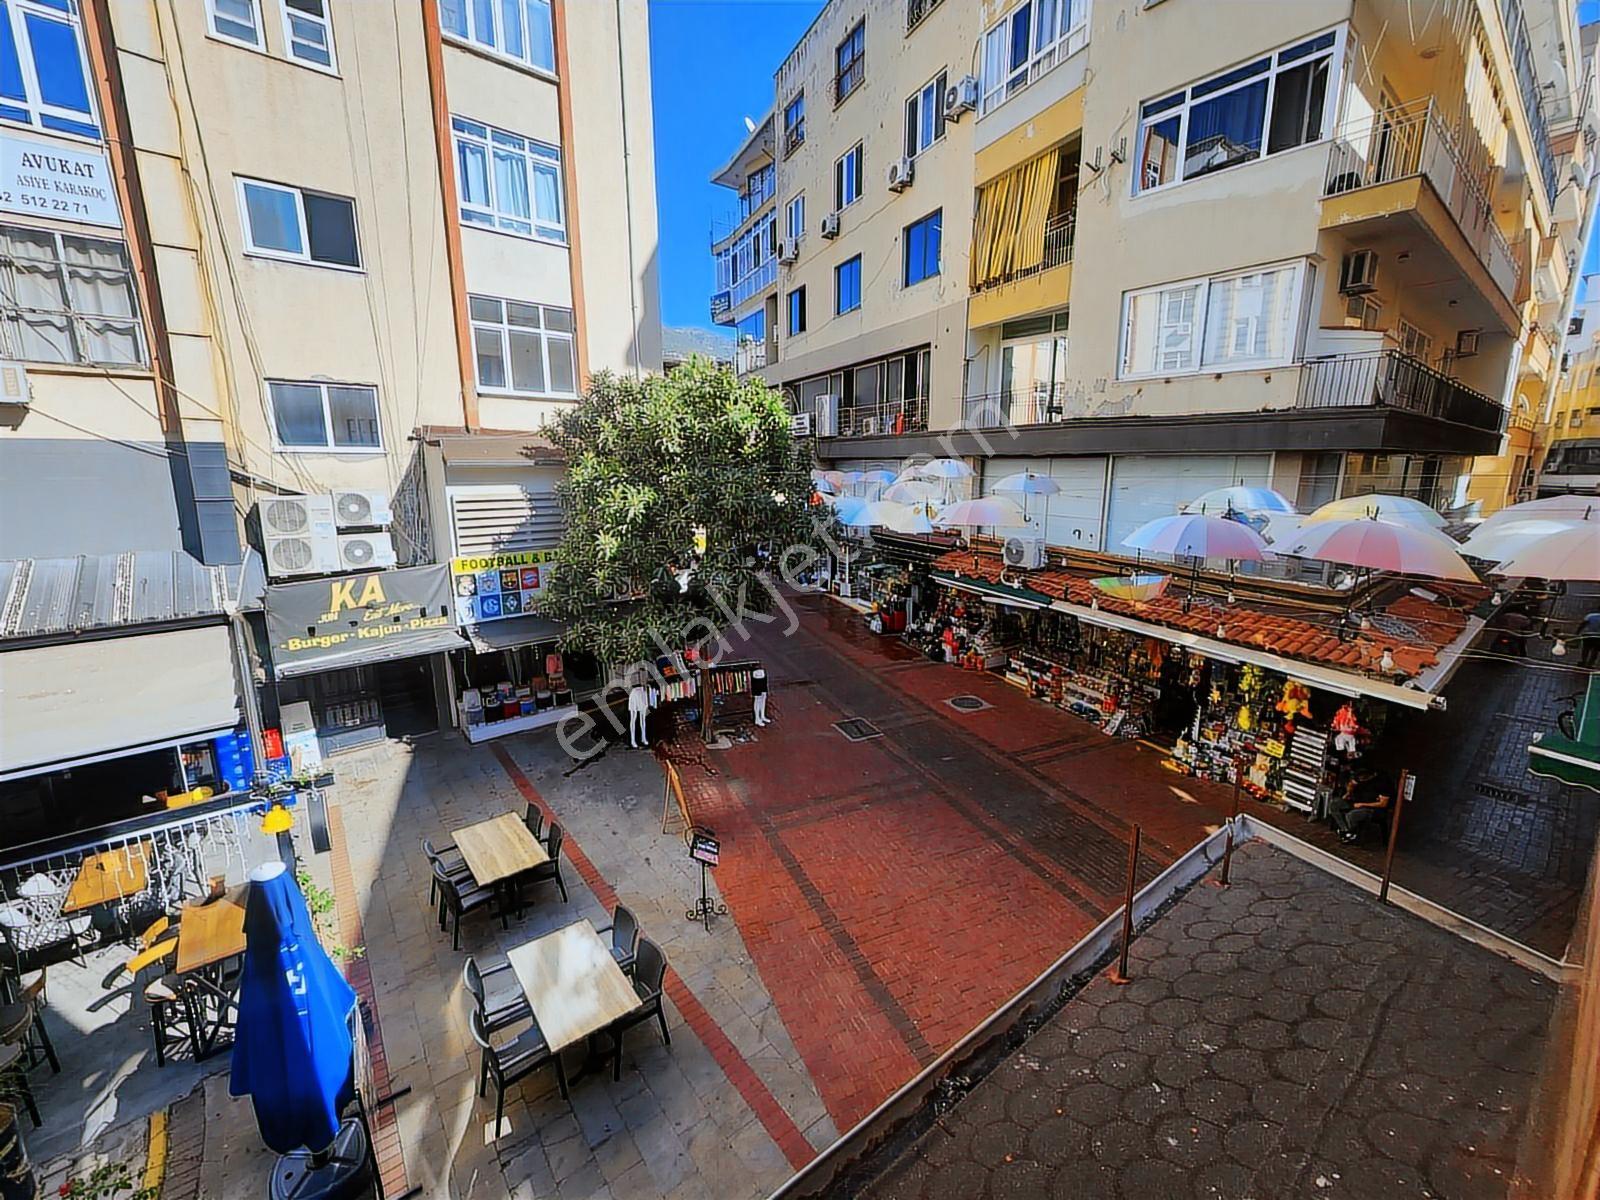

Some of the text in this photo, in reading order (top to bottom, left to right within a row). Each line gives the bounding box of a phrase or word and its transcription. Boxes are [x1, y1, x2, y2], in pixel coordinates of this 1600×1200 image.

[21, 152, 94, 178] AVUKAT
[0, 191, 90, 215] 2 512 22 71
[461, 553, 528, 570] FOOTBALL
[330, 574, 387, 613] KA
